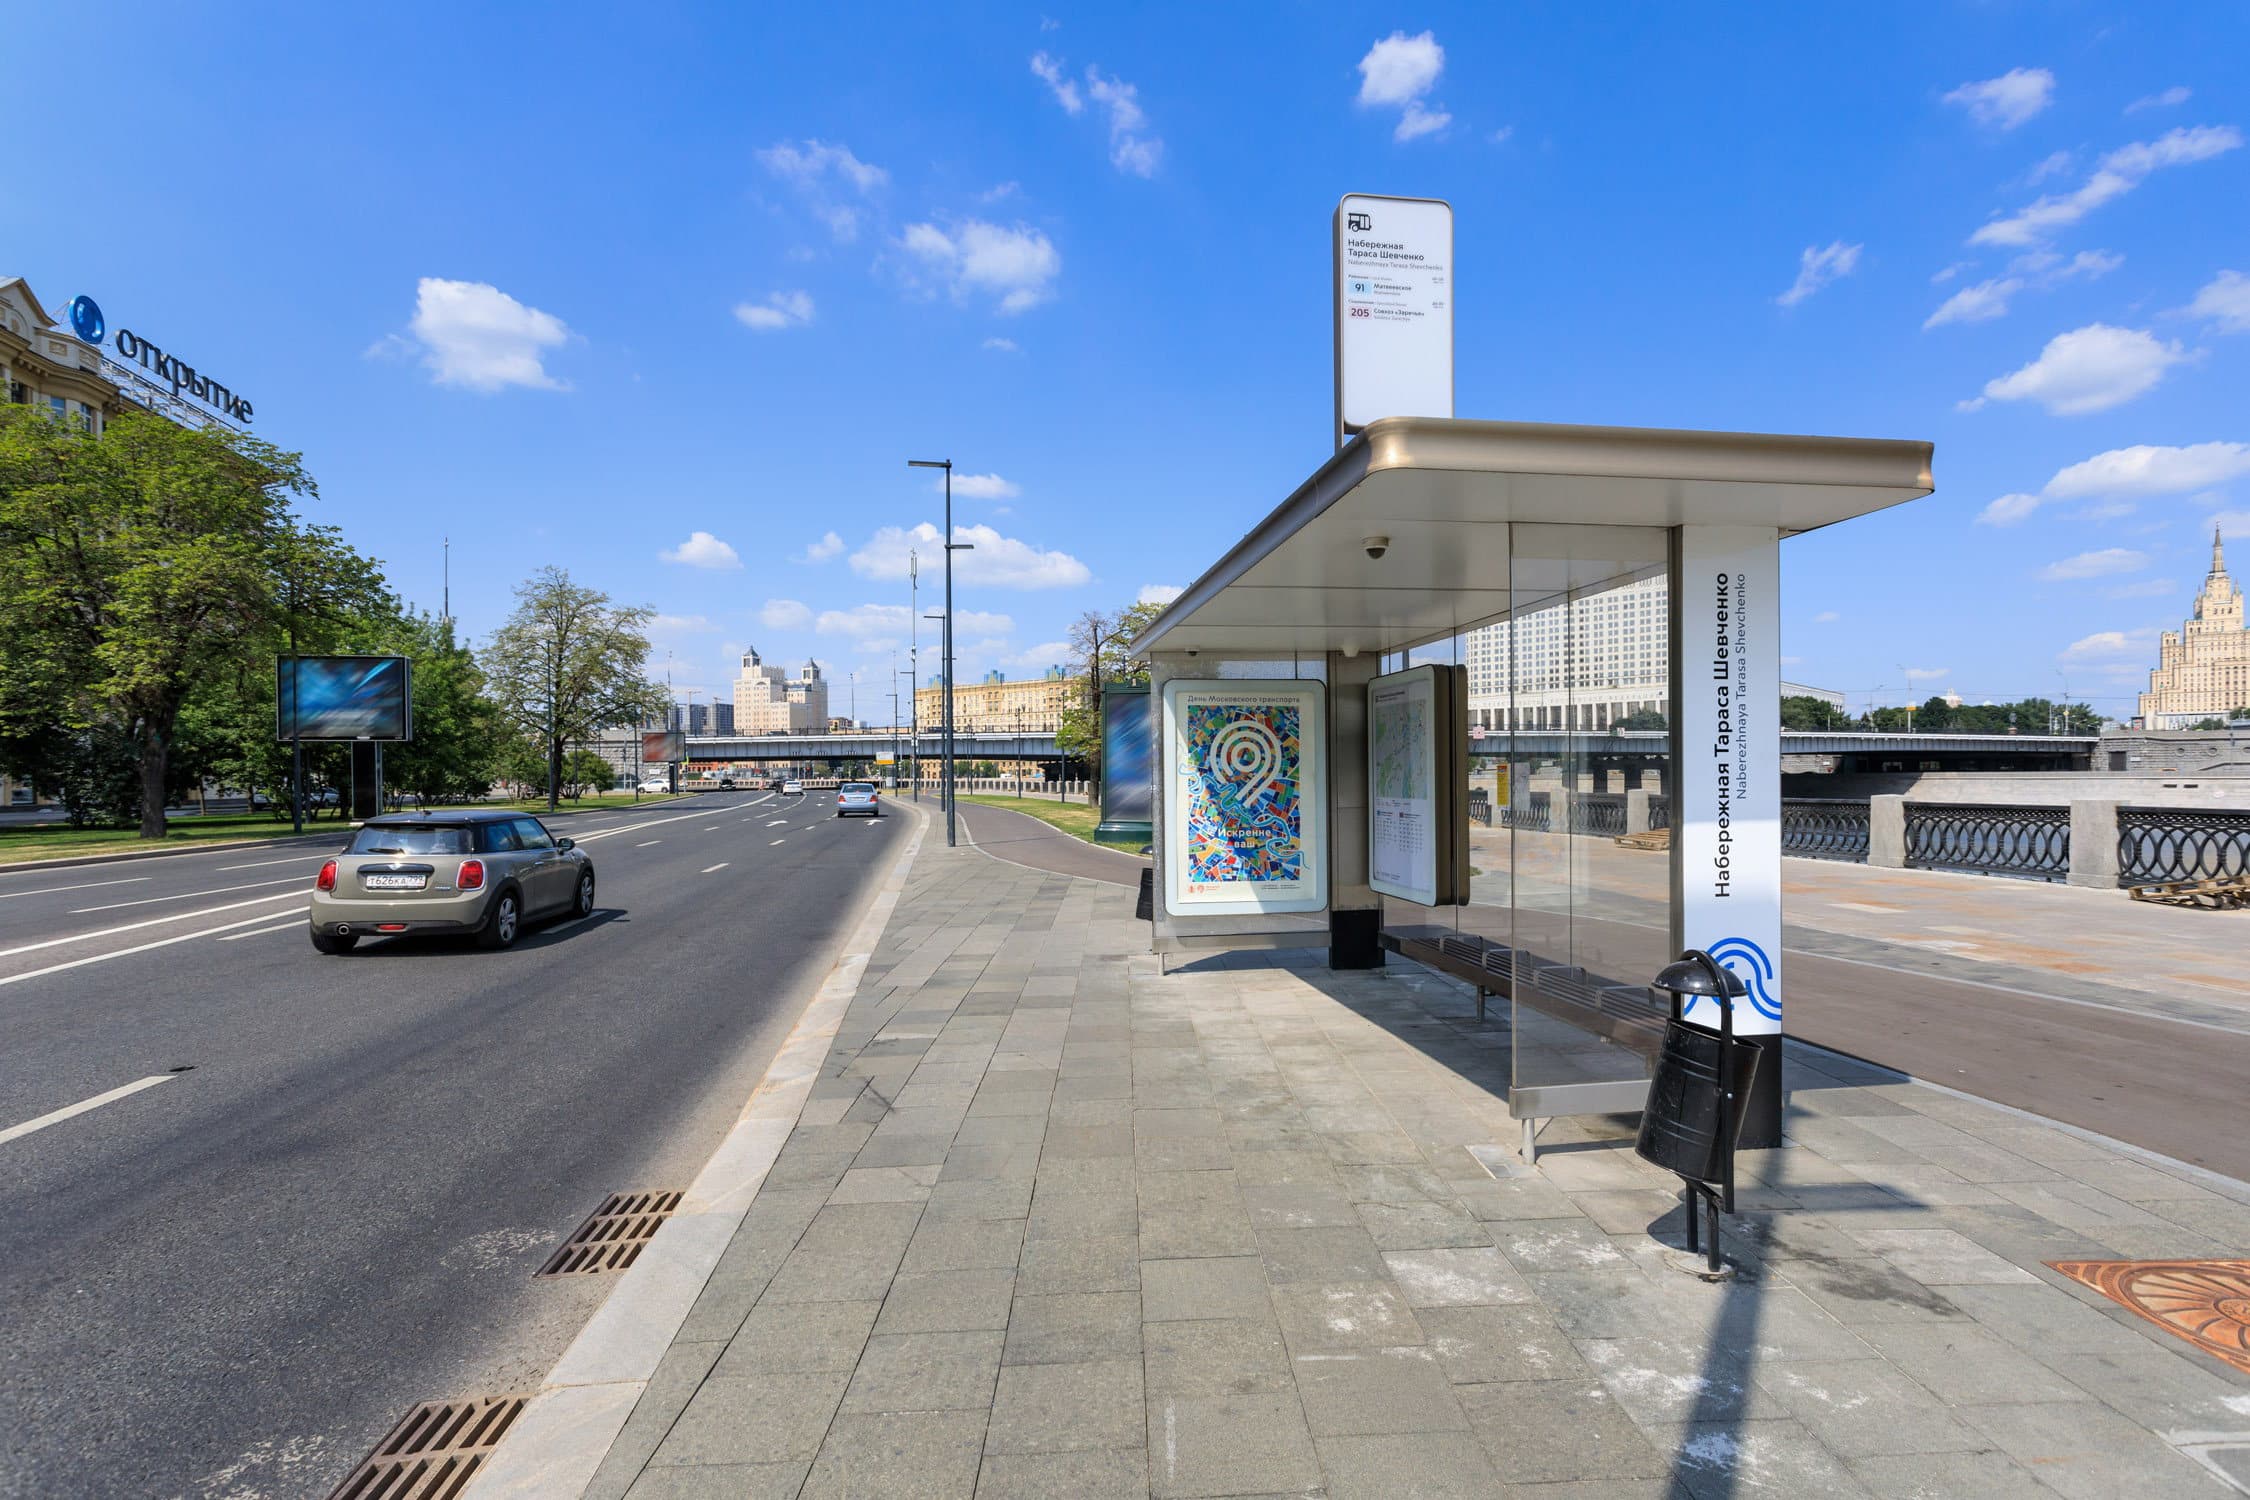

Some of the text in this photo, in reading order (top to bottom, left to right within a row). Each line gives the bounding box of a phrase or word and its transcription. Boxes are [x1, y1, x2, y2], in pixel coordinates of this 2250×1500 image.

[1348, 239, 1404, 250] Набережная
[1348, 248, 1425, 261] Тараса Шевченко
[1355, 283, 1365, 293] 91
[1351, 307, 1370, 318] 205
[1734, 573, 1749, 800] Naberezhnaya Tarasa Shevchenko
[1713, 573, 1734, 898] Набережная Тараса Шевченко
[1218, 828, 1272, 839] Искренне
[1234, 841, 1256, 849] ваш
